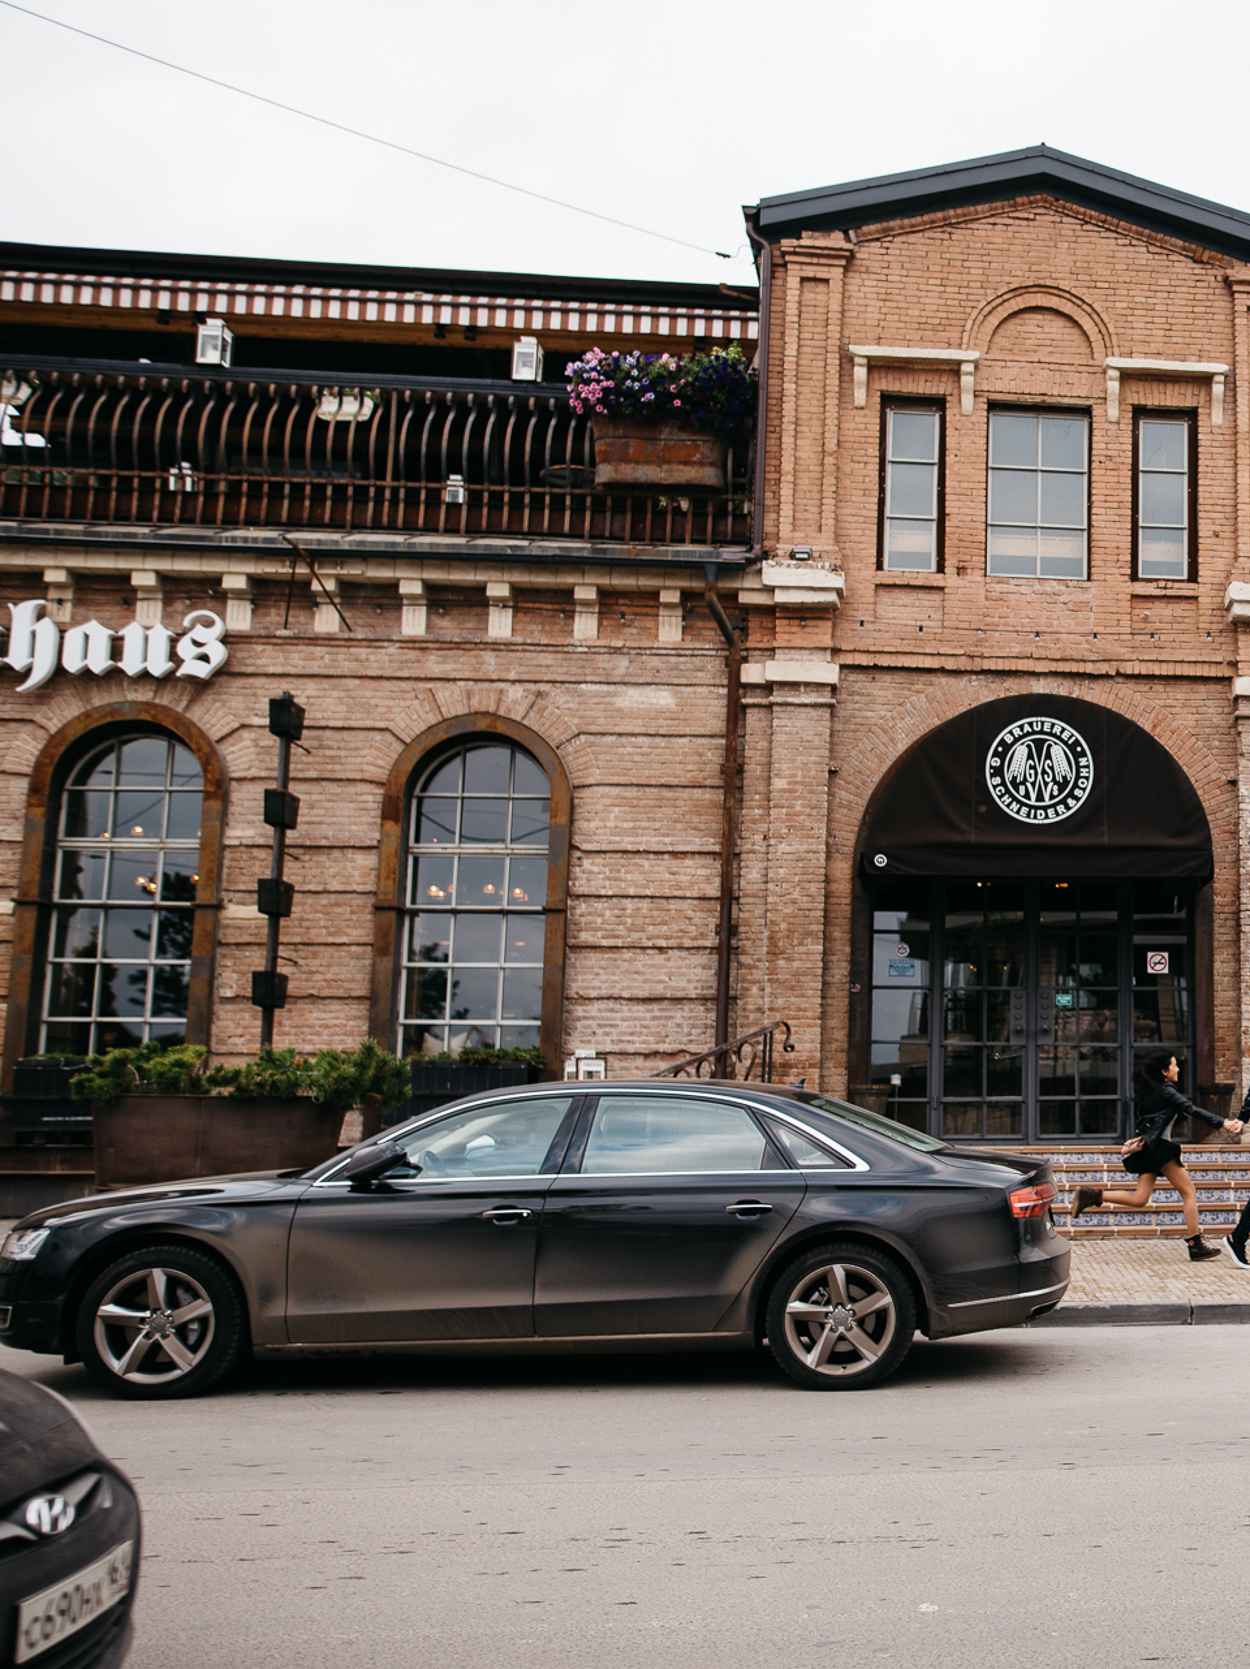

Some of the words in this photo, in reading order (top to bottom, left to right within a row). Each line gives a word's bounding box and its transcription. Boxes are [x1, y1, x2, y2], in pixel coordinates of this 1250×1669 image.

[0, 600, 228, 692] haus
[1003, 722, 1076, 744] BRAUEREI
[991, 777, 1067, 820] SCHNEIDER
[1073, 757, 1090, 797] SOHN
